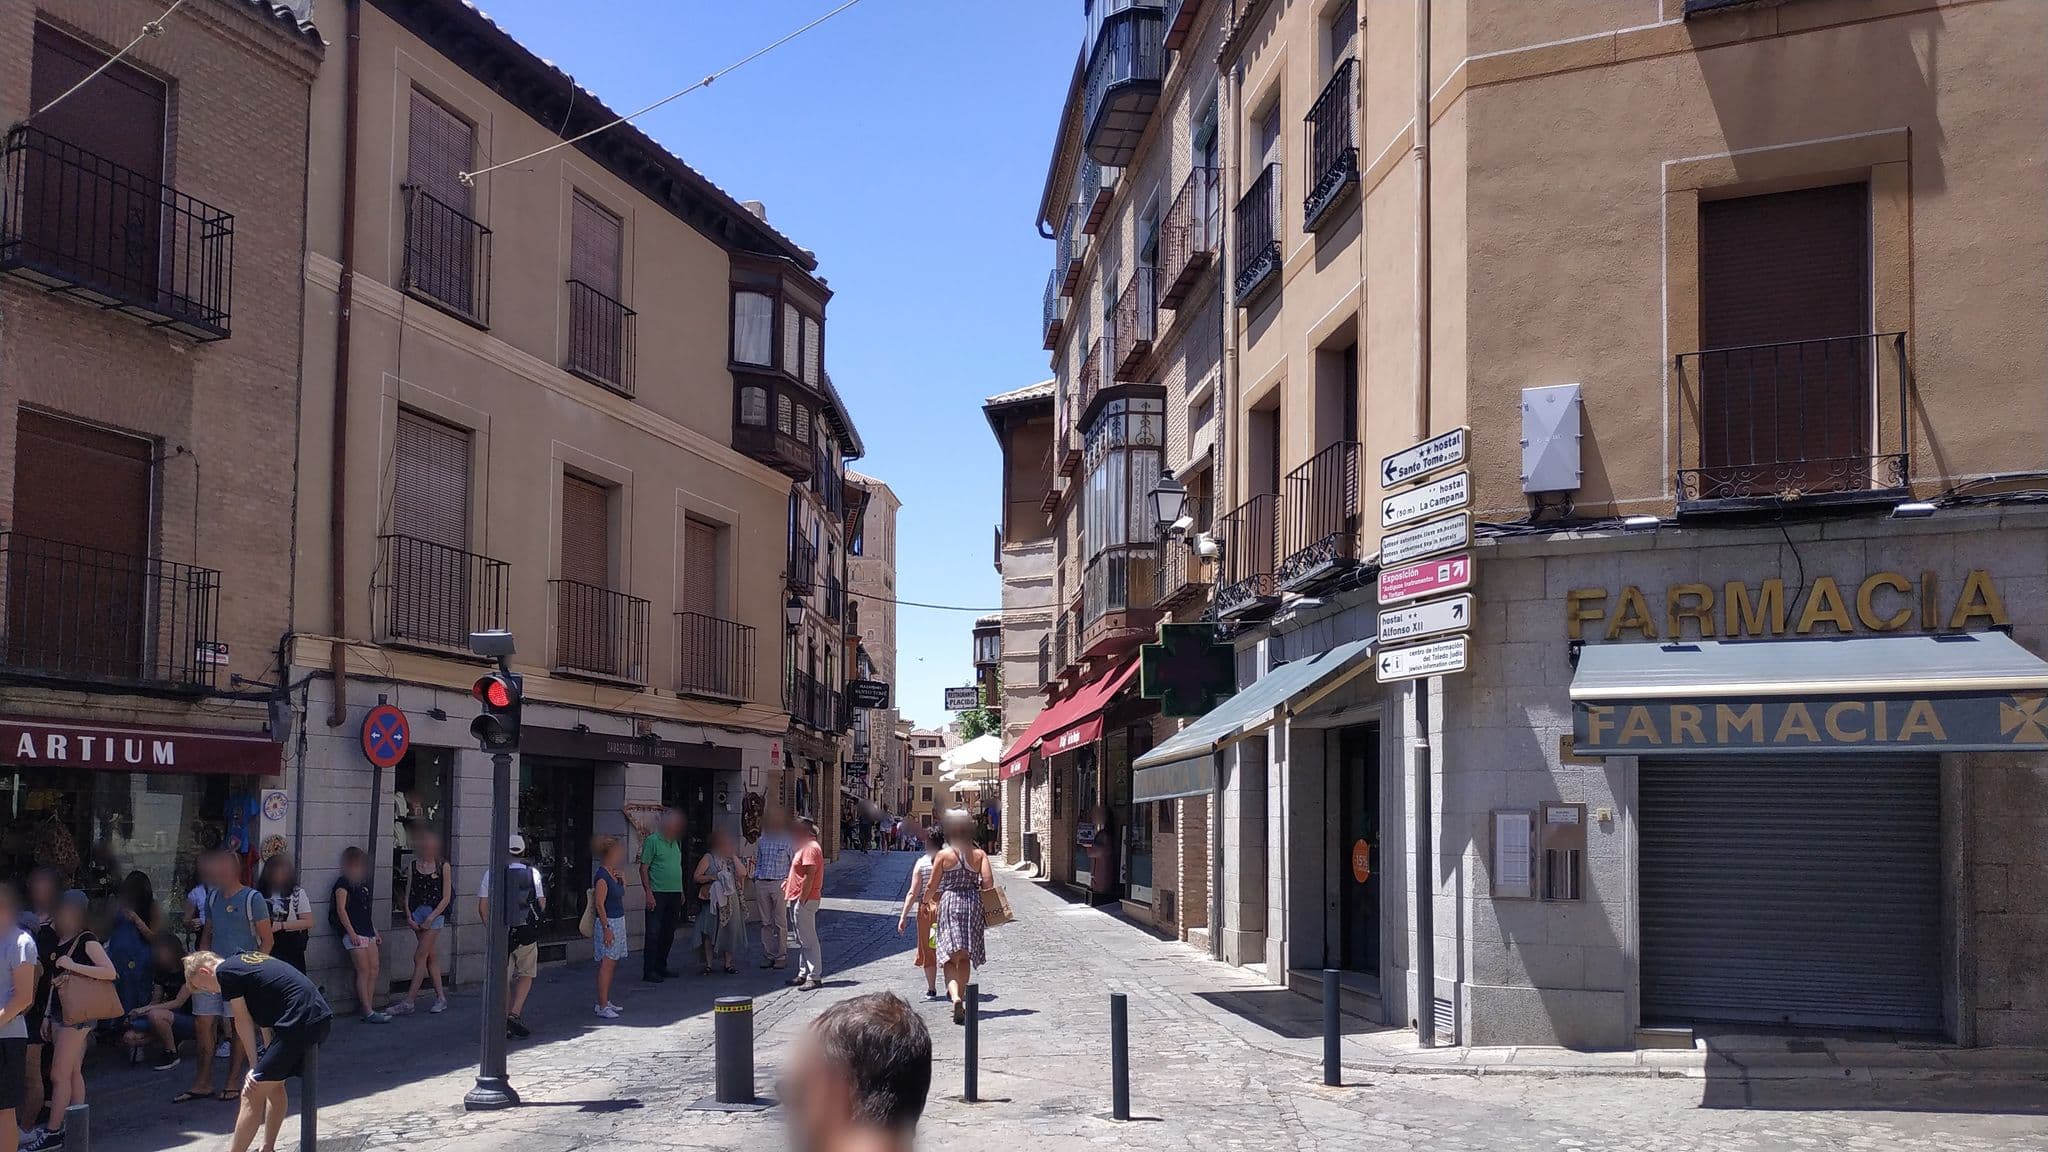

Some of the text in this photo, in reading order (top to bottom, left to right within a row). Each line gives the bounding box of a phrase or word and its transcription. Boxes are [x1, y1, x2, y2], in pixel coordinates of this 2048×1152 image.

[1434, 434, 1460, 452] hostal
[1398, 463, 1420, 477] Santo
[1439, 478, 1464, 494] hostal
[1419, 501, 1429, 511] La
[1429, 490, 1464, 508] Campana
[1382, 568, 1419, 584] Exposición
[1567, 569, 2007, 640] FARMACIA
[1382, 614, 1403, 625] hostal
[1382, 621, 1423, 638] Alfonso XII
[1409, 648, 1425, 657] centro
[1432, 642, 1463, 652] información
[1423, 654, 1431, 663] del
[1432, 652, 1448, 661] Toledo
[1422, 661, 1447, 670] information
[1448, 659, 1462, 667] center
[1587, 699, 1947, 746] FARMACIA
[16, 732, 175, 766] ARTIUM
